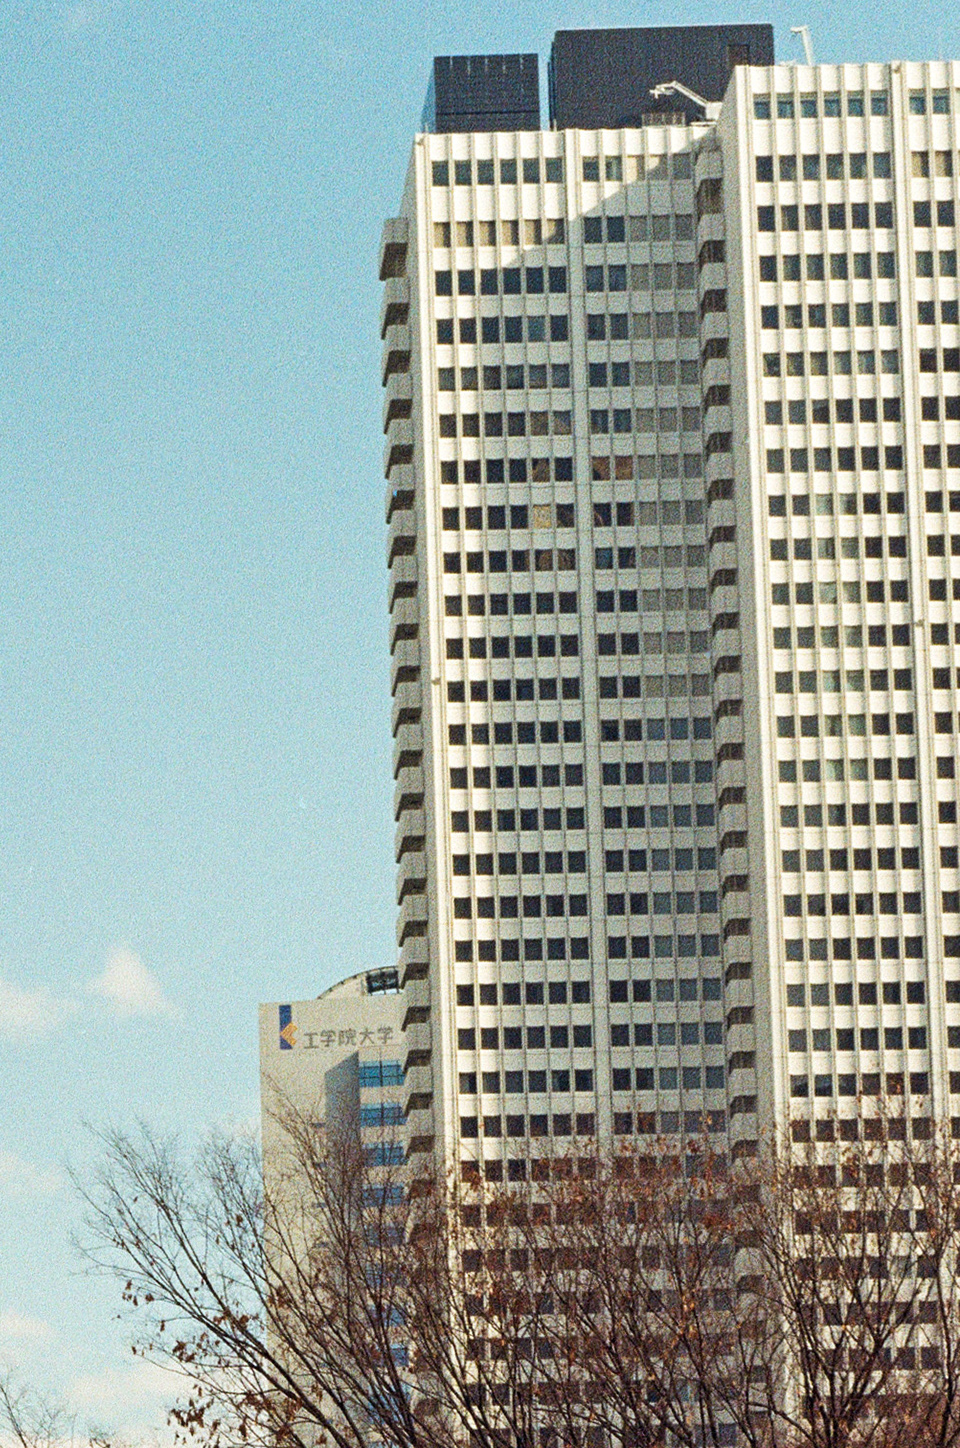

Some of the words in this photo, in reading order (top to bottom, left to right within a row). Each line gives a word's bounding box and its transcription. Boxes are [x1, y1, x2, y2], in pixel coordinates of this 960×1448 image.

[303, 1025, 394, 1049] 工学院大学
